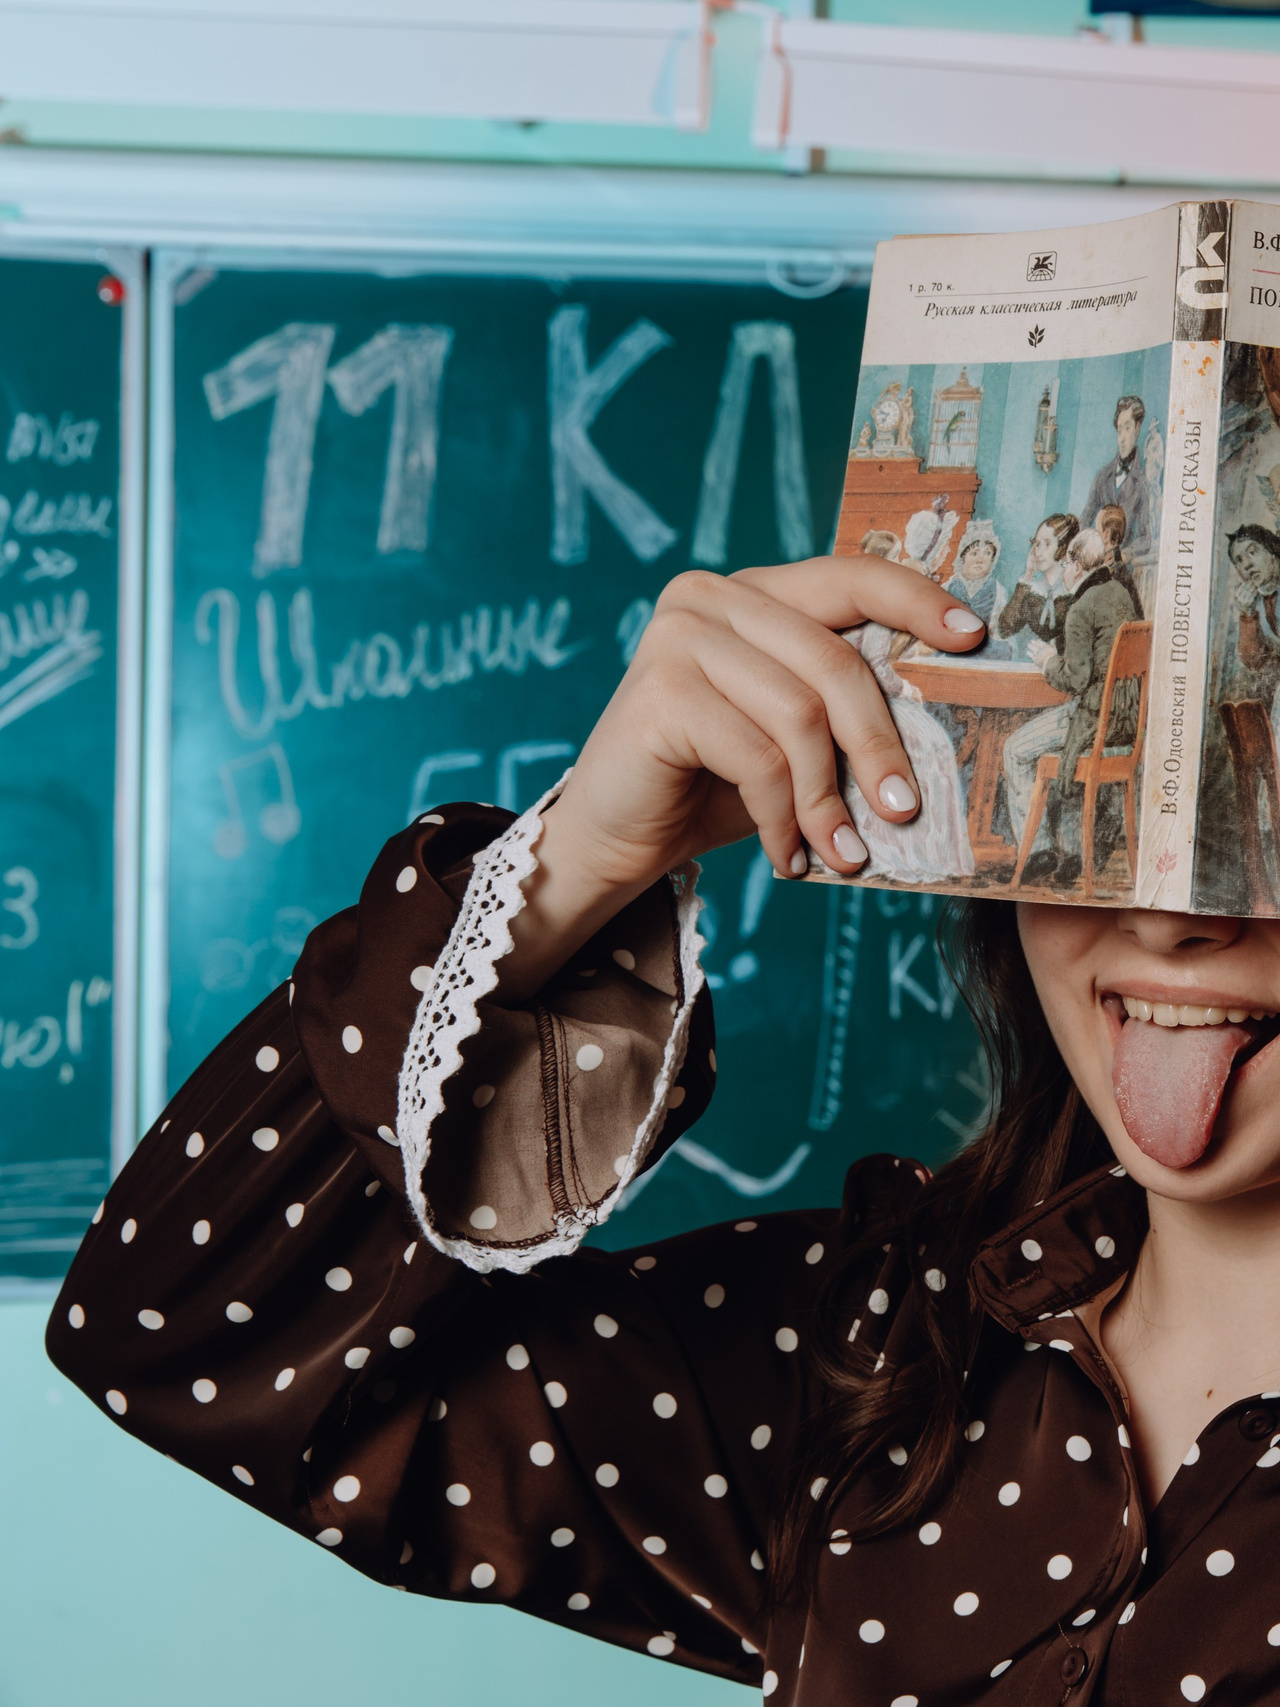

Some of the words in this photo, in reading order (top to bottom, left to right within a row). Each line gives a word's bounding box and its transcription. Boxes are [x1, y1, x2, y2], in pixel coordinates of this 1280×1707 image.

[924, 302, 975, 320] Русская
[979, 299, 1062, 315] классическая
[1066, 290, 1138, 312] литература
[931, 282, 943, 292] 70
[1179, 420, 1202, 532] РАССКАЗЫ
[1178, 539, 1194, 554] И
[1170, 564, 1193, 664] ПОВЕСТИ
[1161, 675, 1187, 816] В.Ф.Одоевский
